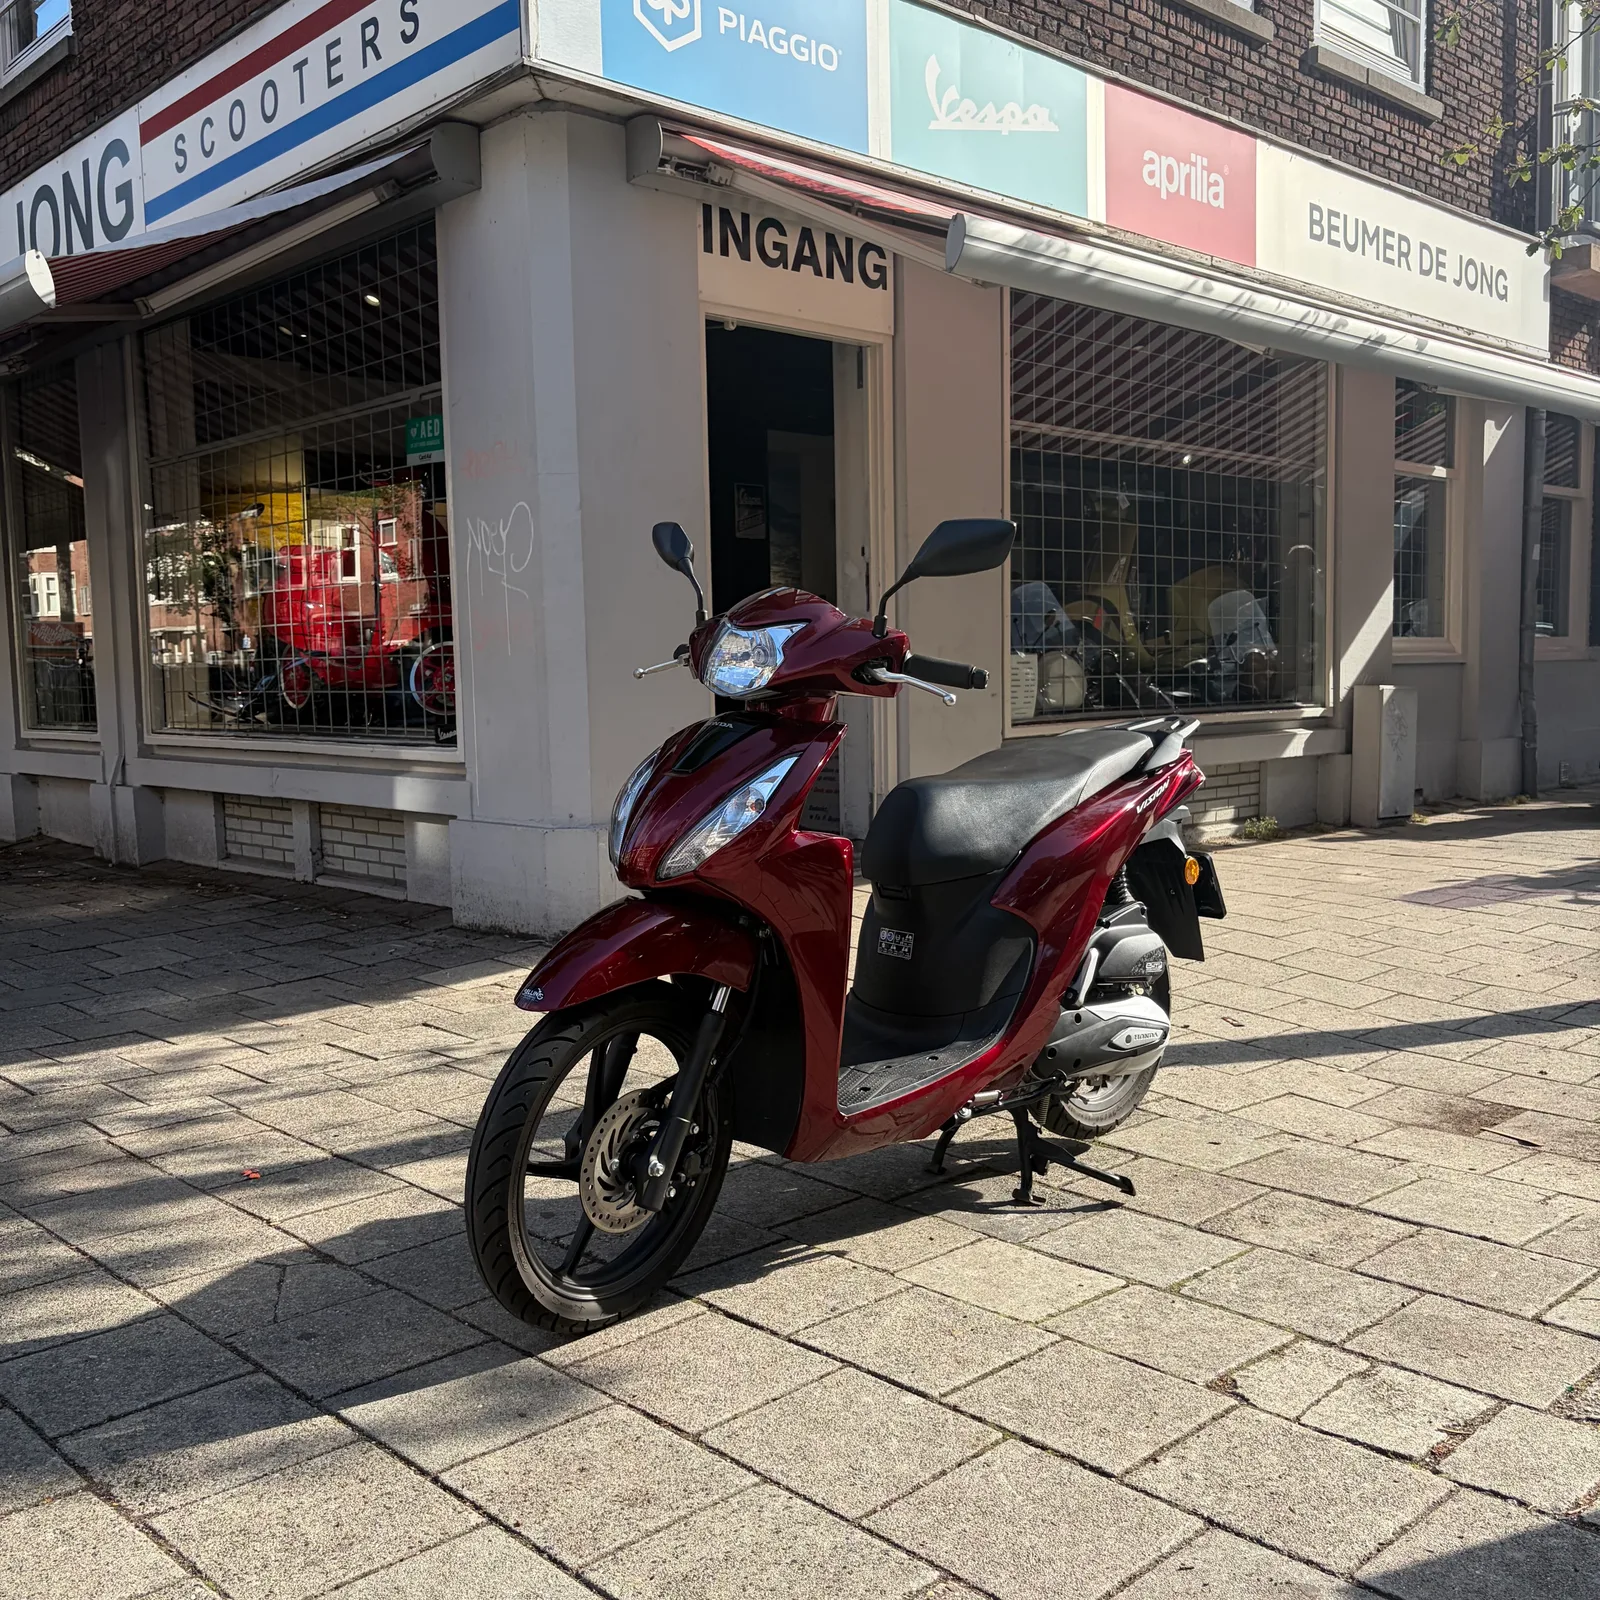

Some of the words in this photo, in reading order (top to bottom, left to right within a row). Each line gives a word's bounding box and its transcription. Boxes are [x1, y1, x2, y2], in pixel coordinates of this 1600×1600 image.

[718, 6, 838, 72] PIAGGIO
[174, 0, 420, 174] SCOOTERS
[925, 53, 1060, 135] Vespa
[1142, 149, 1225, 209] aprilia
[702, 202, 888, 290] INGANG
[1309, 202, 1412, 272] BEUMER
[1419, 241, 1447, 283] DE
[1453, 254, 1508, 302] JONG
[420, 418, 440, 438] AED
[1136, 776, 1170, 813] VISION
